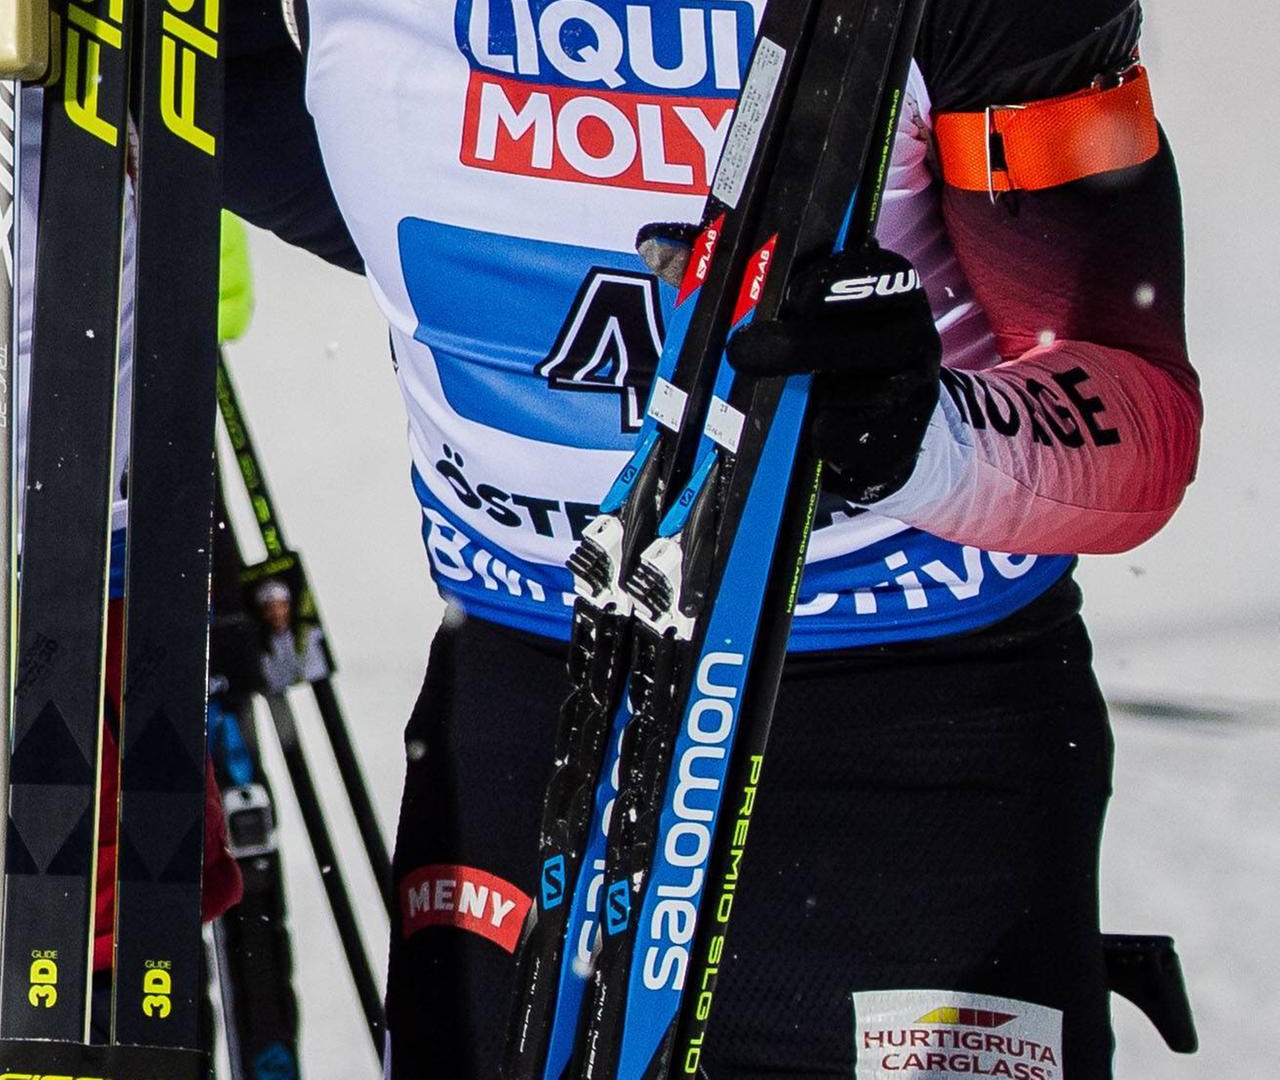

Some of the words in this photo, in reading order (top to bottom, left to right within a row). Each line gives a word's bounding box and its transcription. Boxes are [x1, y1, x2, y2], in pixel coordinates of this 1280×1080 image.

[473, 72, 734, 185] MOLY
[642, 651, 745, 992] salomon
[715, 754, 764, 924] PREMIO
[408, 878, 517, 928] MENY
[27, 958, 58, 1009] 3D
[142, 968, 173, 1019] 3D
[695, 935, 726, 1022] SLG
[683, 1034, 706, 1075] 10
[863, 1029, 1058, 1067] HURTIGRUTA
